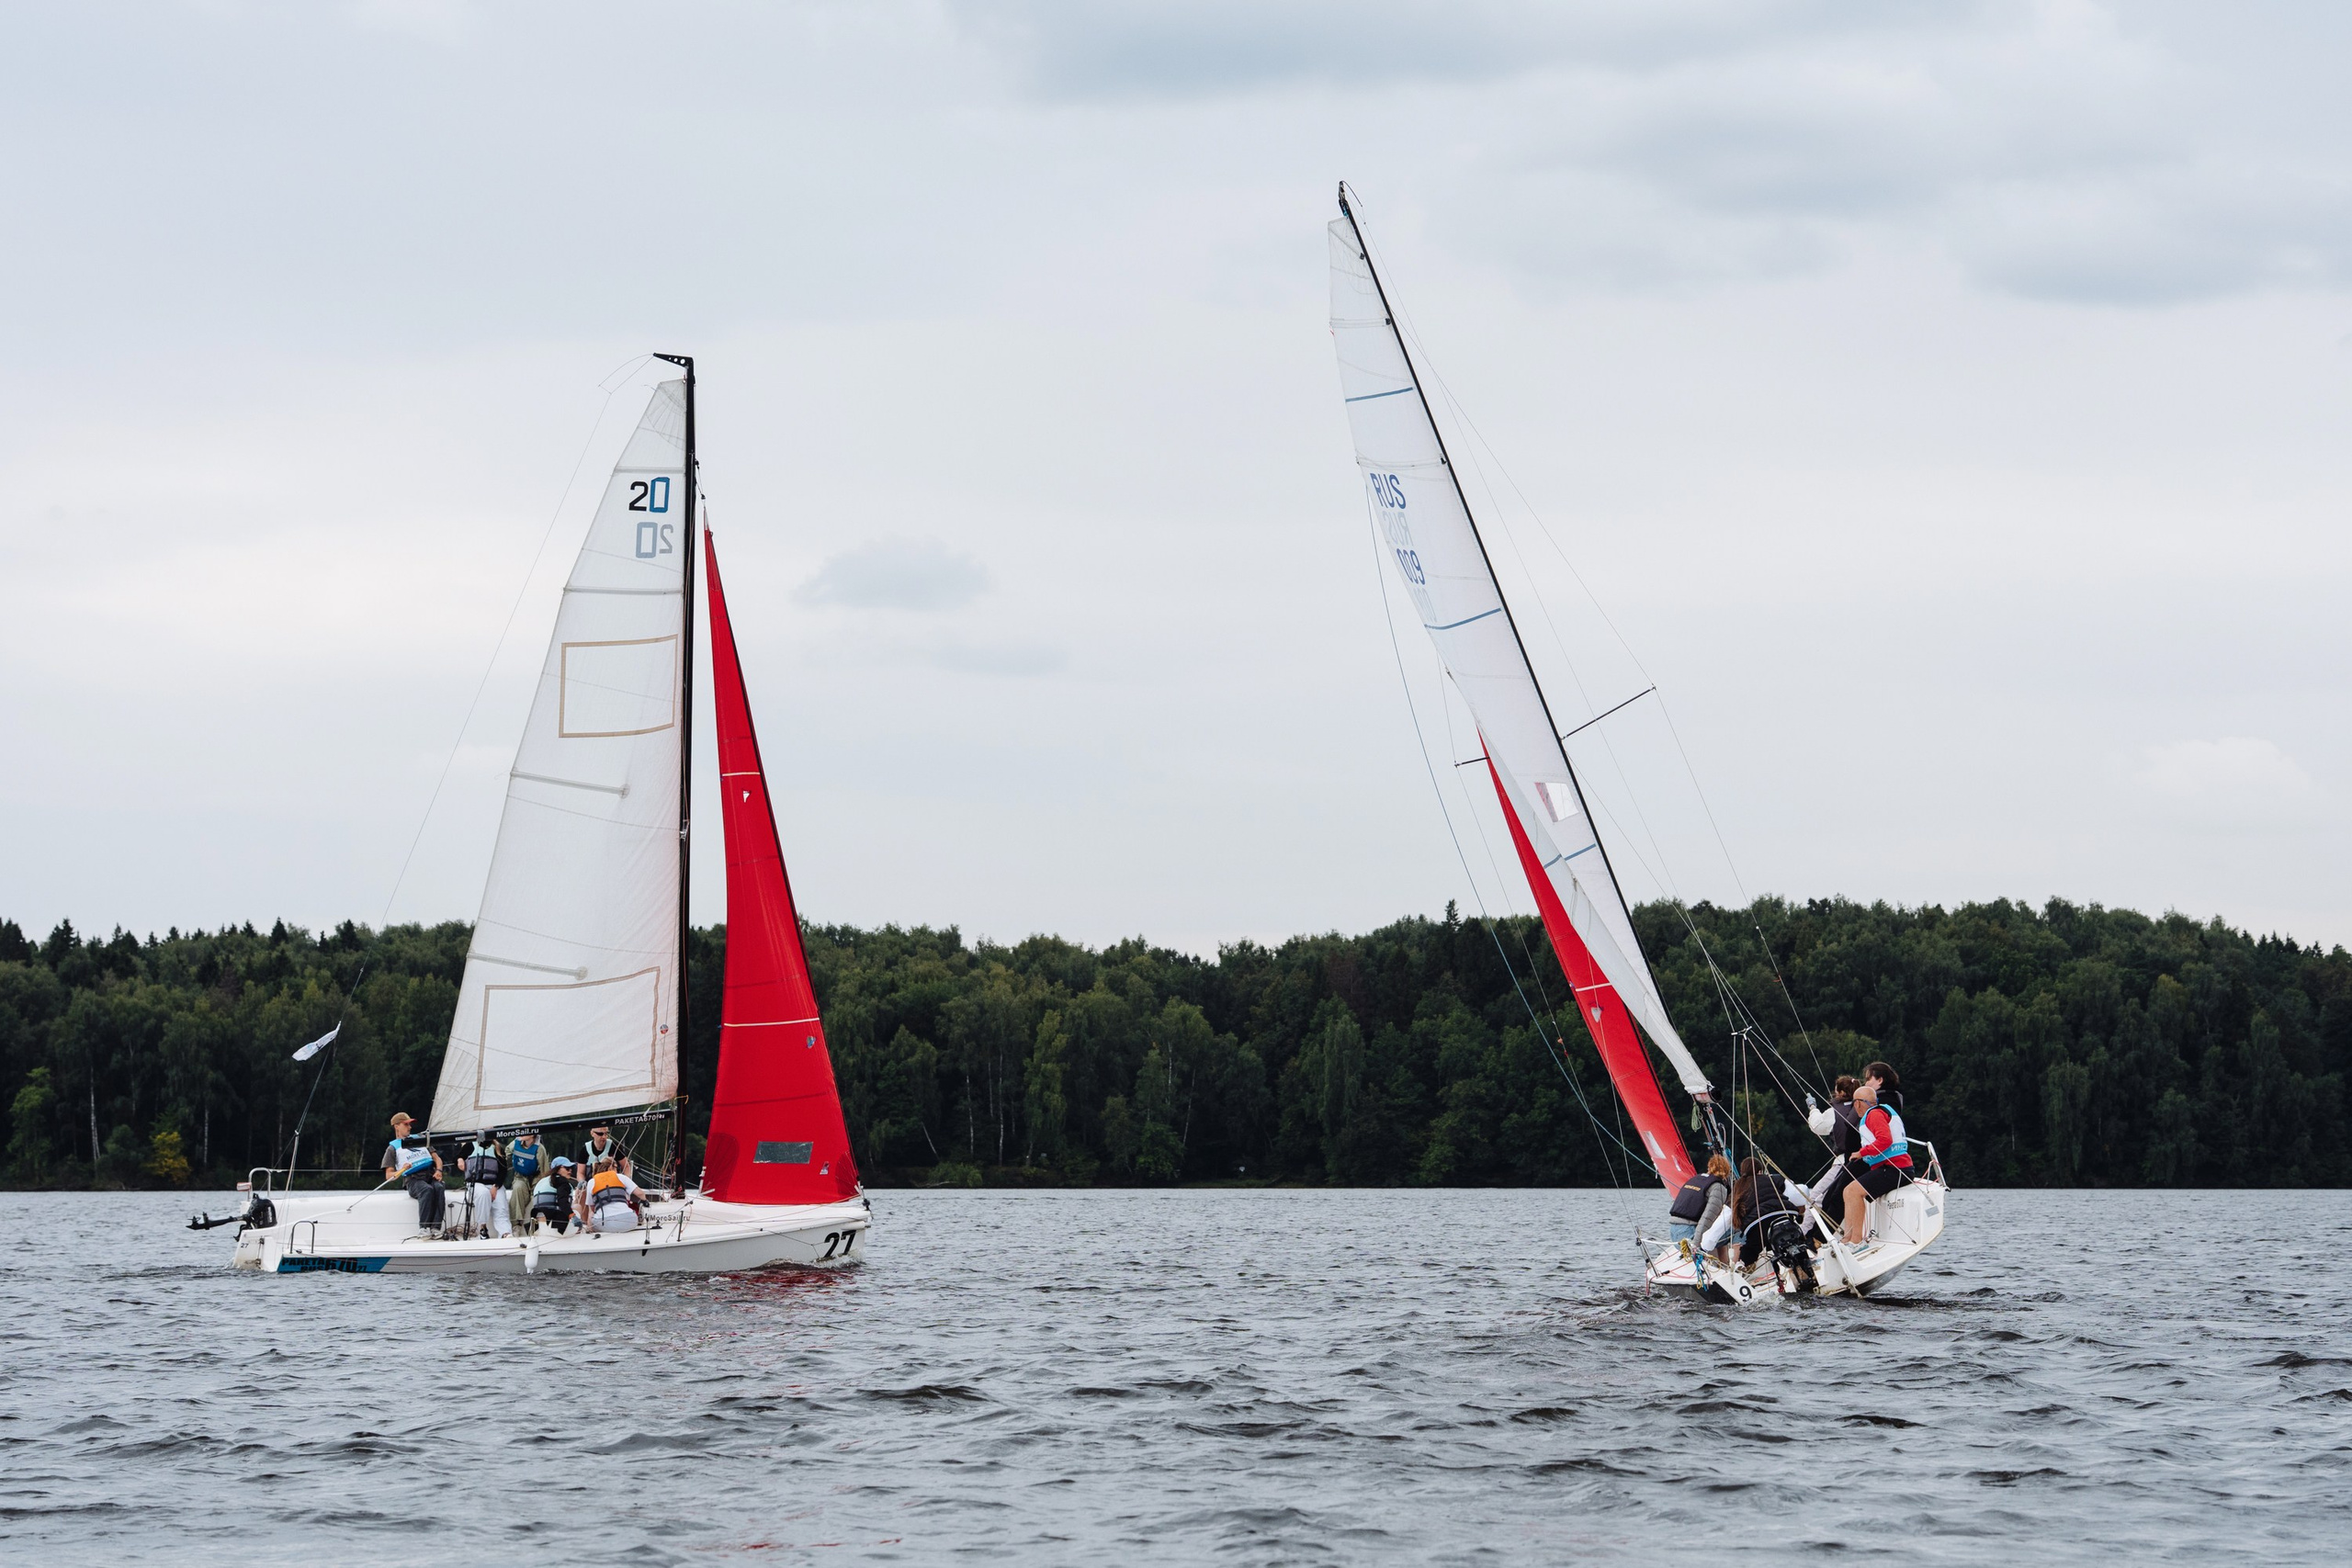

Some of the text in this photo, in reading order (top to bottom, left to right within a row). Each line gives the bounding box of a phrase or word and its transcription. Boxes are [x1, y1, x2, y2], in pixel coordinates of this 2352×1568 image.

[628, 476, 670, 513] 20
[1370, 473, 1406, 509] RUS
[1396, 548, 1425, 584] 009
[496, 1127, 539, 1138] MoreSail.ru
[823, 1230, 856, 1258] 27
[1739, 1285, 1753, 1299] 9
